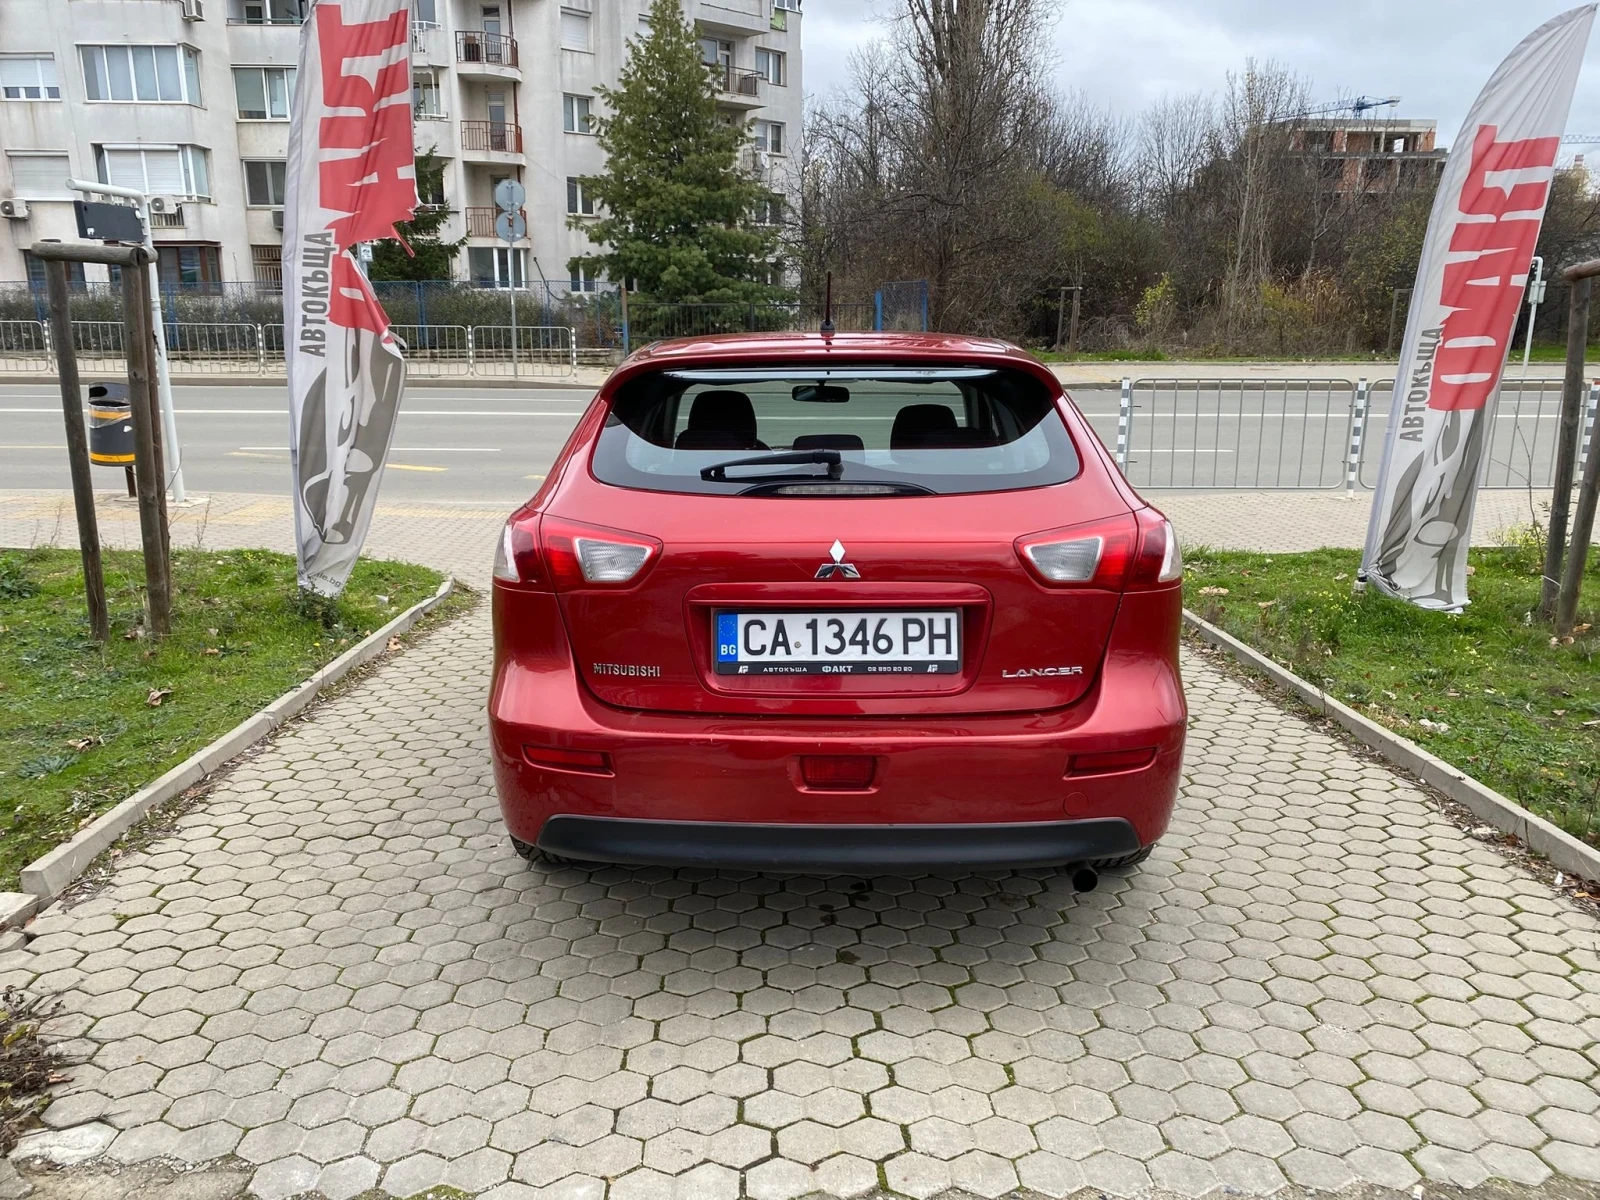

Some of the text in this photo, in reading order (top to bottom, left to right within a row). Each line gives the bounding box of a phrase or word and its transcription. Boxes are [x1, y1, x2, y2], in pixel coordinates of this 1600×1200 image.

[1428, 124, 1560, 412] ФАКТ
[299, 232, 336, 357] АВТОКЪЩА
[1399, 327, 1444, 442] АВТОКЪЩА
[720, 644, 736, 655] BG
[743, 617, 951, 656] CA 1346 PH
[593, 662, 660, 677] MITSUBISHI
[822, 665, 853, 673] ФАКТ
[1002, 666, 1083, 678] LANCER
